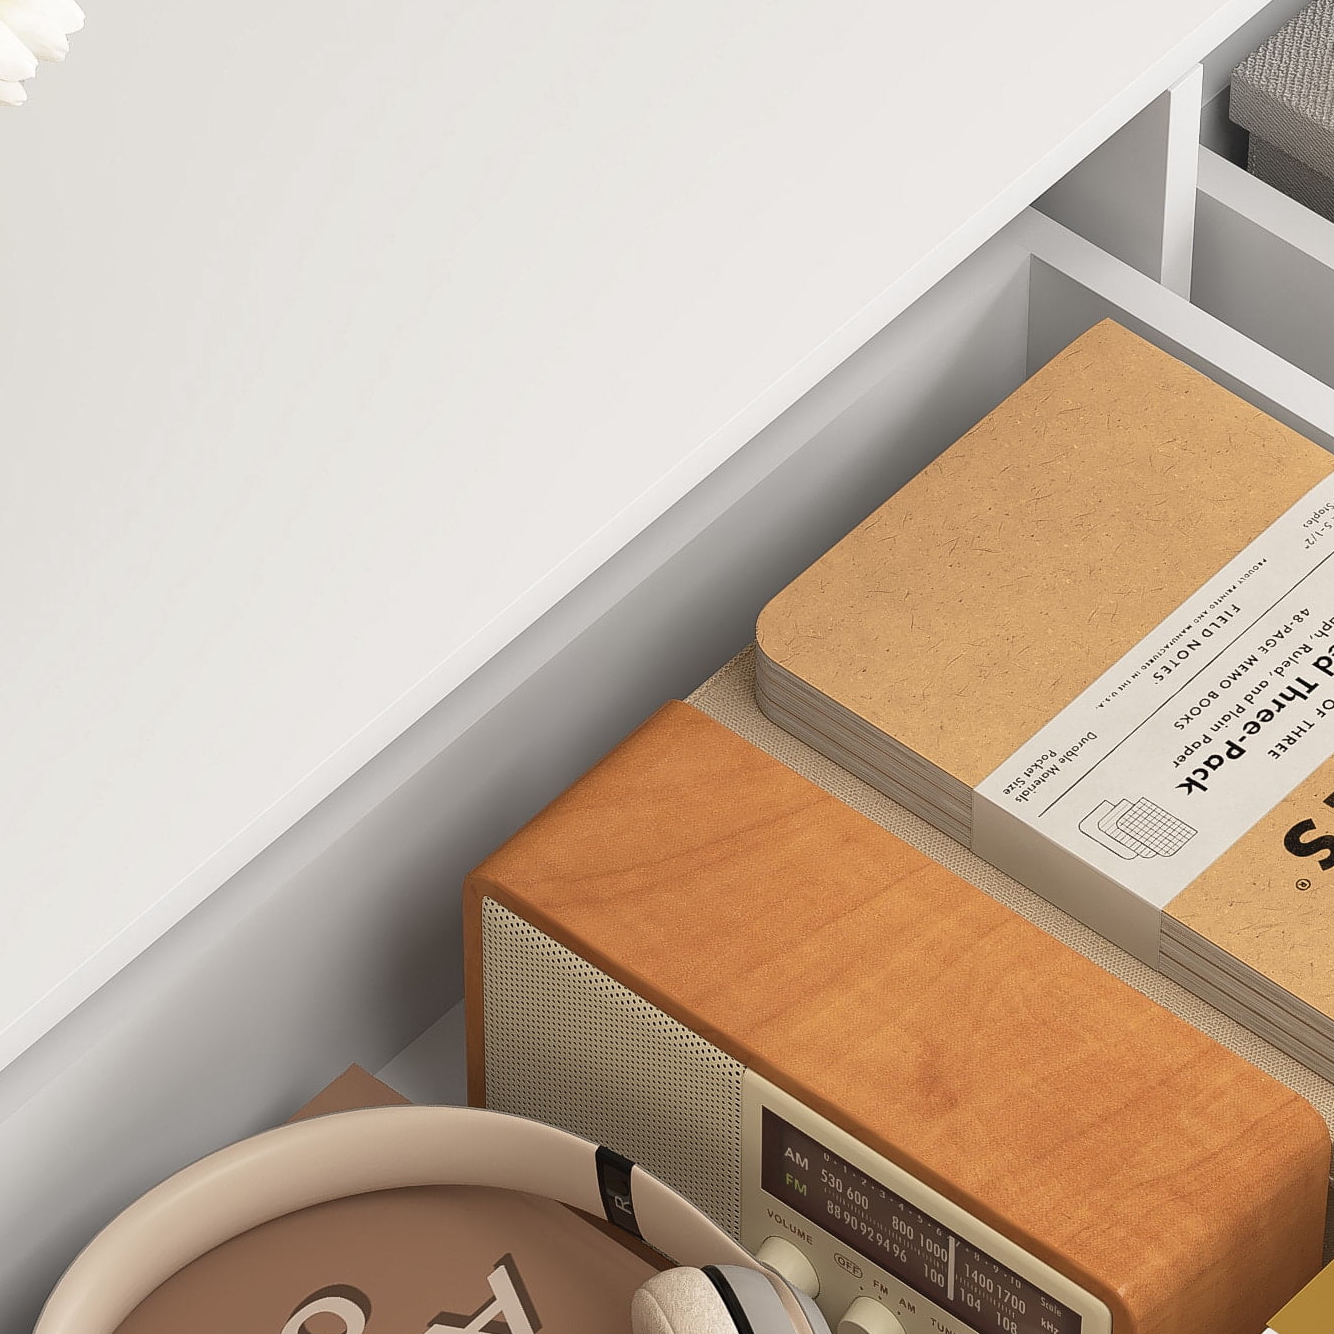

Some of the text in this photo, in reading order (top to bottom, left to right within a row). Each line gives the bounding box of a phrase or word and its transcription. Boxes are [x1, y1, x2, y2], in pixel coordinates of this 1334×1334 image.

[1237, 558, 1267, 585] PROUDLY
[1209, 584, 1237, 610] PRINTED
[1193, 609, 1209, 624] AND
[1201, 603, 1242, 638] FIELD
[1141, 624, 1193, 670] MANUFACTURED
[1269, 643, 1314, 678] Ruled,
[1117, 679, 1132, 692] THE
[1131, 669, 1142, 680] IN
[1173, 607, 1311, 731] 48-PAGE MEMO BOOKS
[1243, 680, 1270, 705] and
[1174, 675, 1320, 796] Three-Pack
[1210, 703, 1247, 733] Plain
[1172, 733, 1213, 769] Paper
[1267, 719, 1316, 761] THREE
[1002, 749, 1058, 795] Pocket Size
[1014, 731, 1098, 803] Durable Materials
[766, 1207, 813, 1246] VOLUME
[784, 1147, 809, 1171] AM
[820, 1169, 843, 1193] 530
[847, 1187, 869, 1210] 600
[892, 1215, 914, 1240] 800
[920, 1233, 948, 1263] 1000
[965, 1263, 994, 1293] 1400
[997, 1284, 1026, 1315] 1700
[785, 1172, 808, 1196] FM
[827, 1200, 841, 1219] 88
[843, 1211, 858, 1230] 90
[860, 1222, 874, 1242] 92
[876, 1233, 890, 1252] 94
[893, 1244, 907, 1263] 96
[924, 1263, 945, 1288] 100
[959, 1287, 981, 1313] 104
[837, 1255, 916, 1314] OFF FM AM
